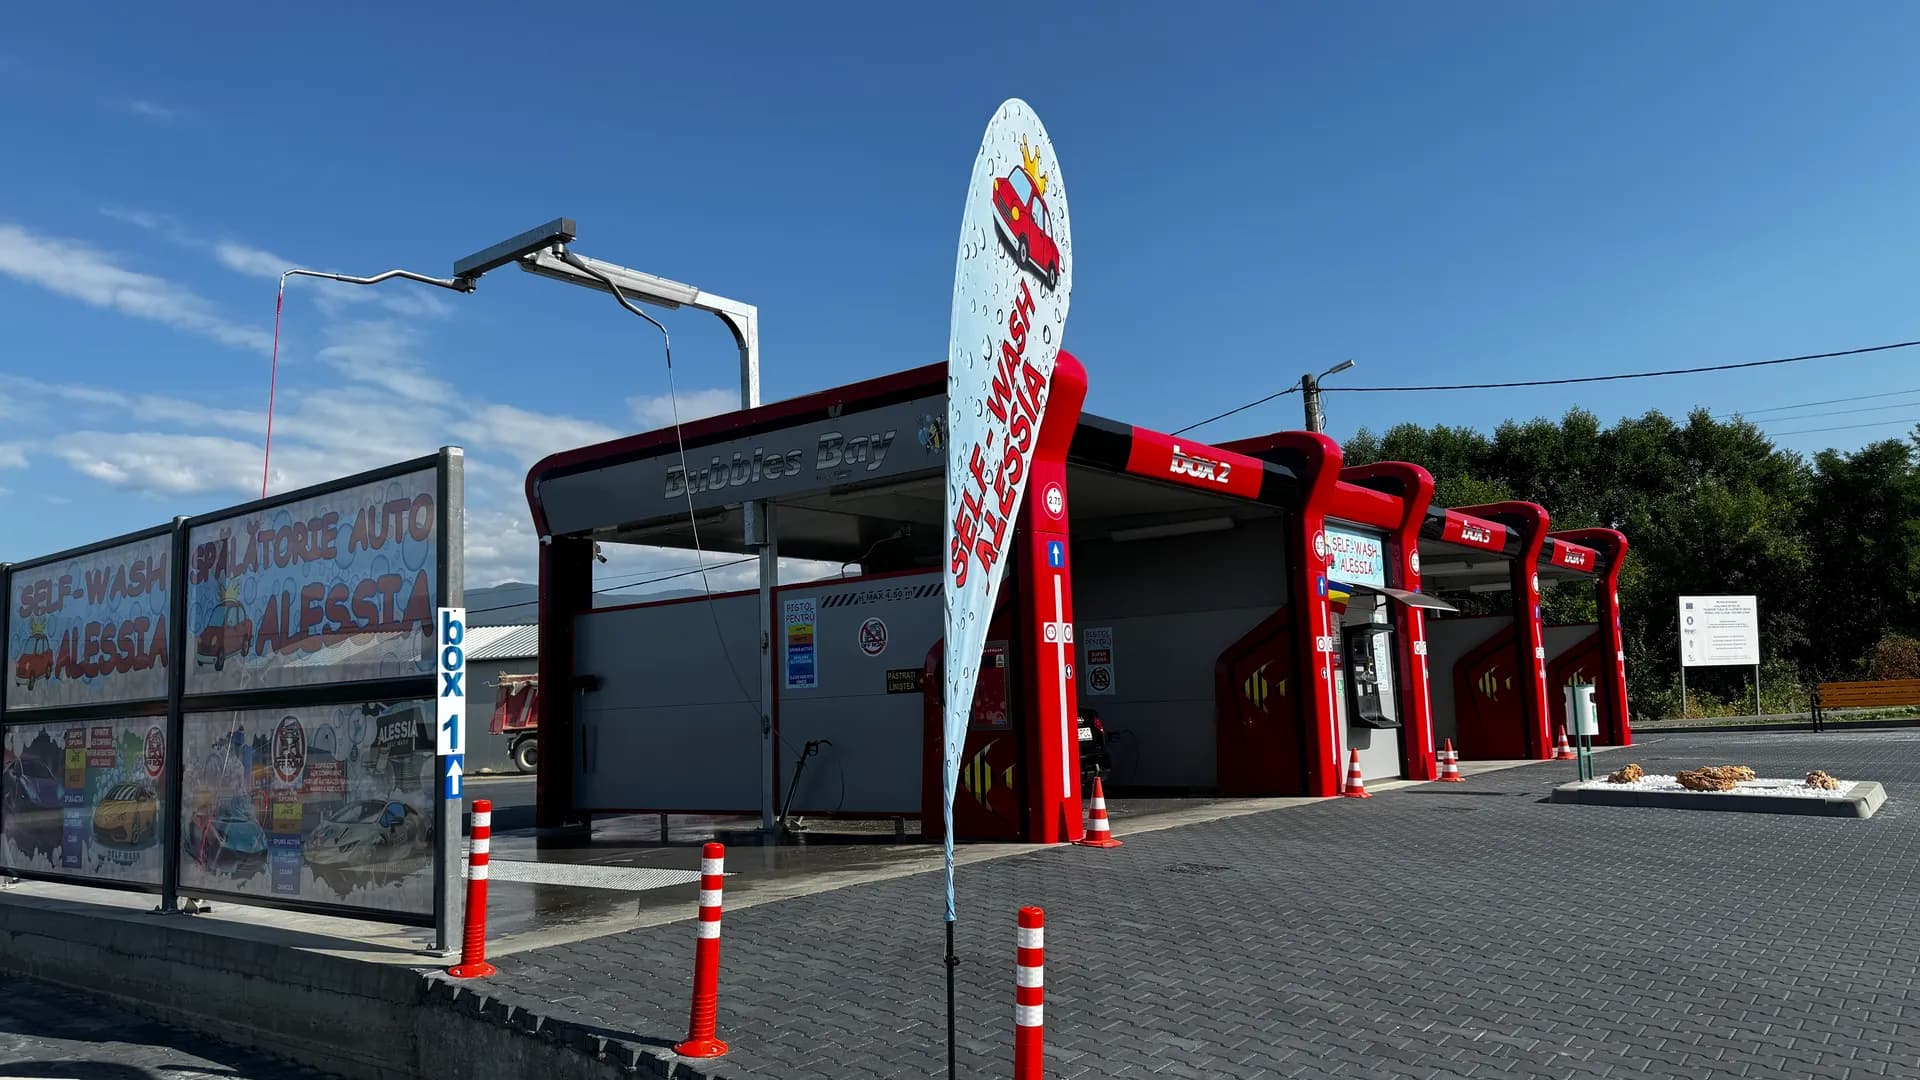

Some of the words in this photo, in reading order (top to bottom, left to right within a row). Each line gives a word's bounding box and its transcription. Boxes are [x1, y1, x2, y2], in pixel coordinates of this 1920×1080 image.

[663, 447, 803, 500] Bubbles
[815, 429, 897, 472] Bay
[975, 359, 1047, 594] ALESSIA
[1169, 444, 1218, 481] box
[1216, 462, 1232, 484] 2
[190, 511, 339, 585] SPĂLĂTORIE
[348, 492, 435, 553] AUTO
[1340, 557, 1375, 576] ALESSIA
[19, 552, 168, 618] SELF-WASH
[254, 569, 434, 657] ALESSIA
[866, 592, 883, 601] MAX
[55, 613, 169, 680] ALESSIA
[785, 613, 815, 624] PENTRU
[440, 611, 465, 697] box
[377, 719, 419, 745] ALESSIA
[442, 714, 459, 750] 1
